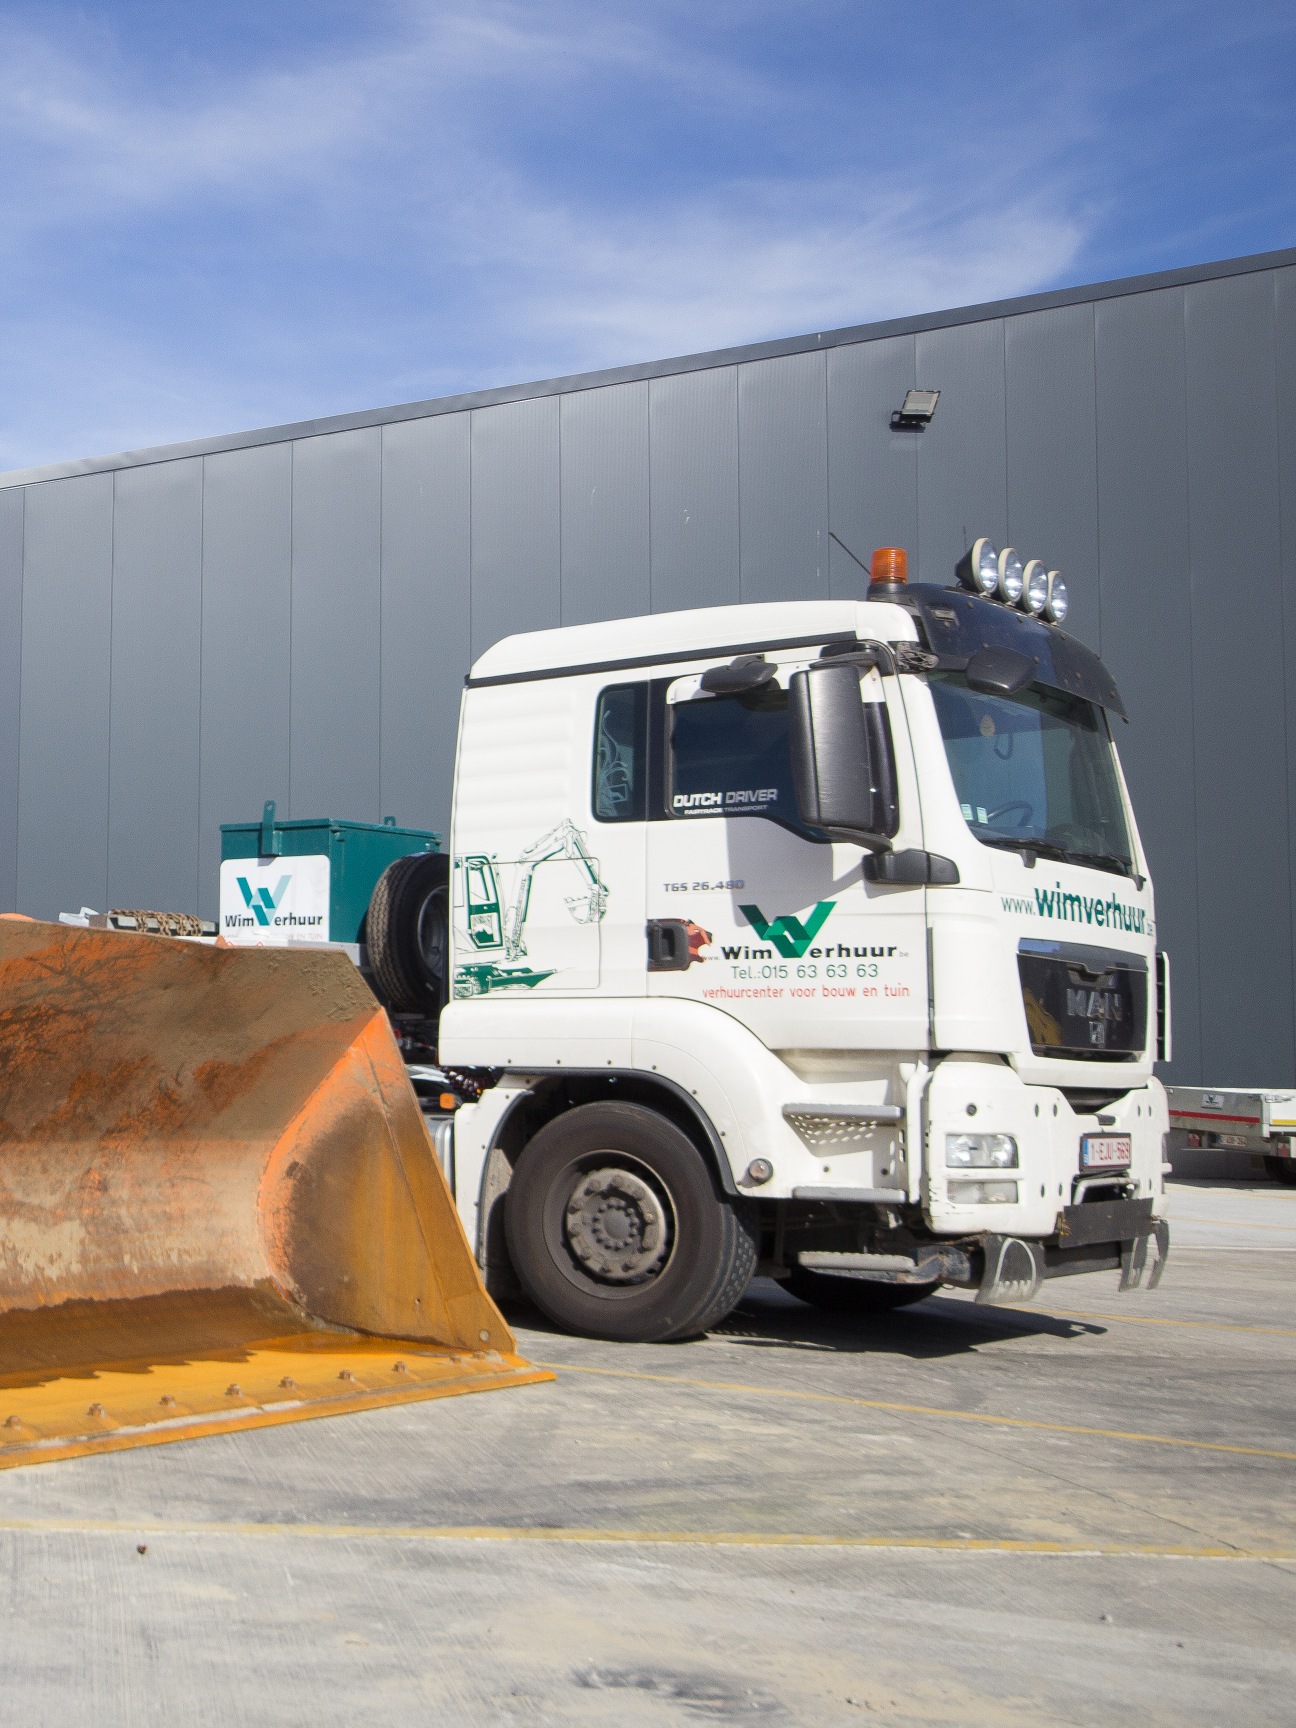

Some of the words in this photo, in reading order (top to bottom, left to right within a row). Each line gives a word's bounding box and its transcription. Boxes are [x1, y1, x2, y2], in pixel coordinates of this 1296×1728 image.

[673, 792, 723, 808] DUTCH
[725, 788, 778, 804] DRIVER
[724, 804, 768, 813] TRANSPORT
[225, 914, 254, 927] Wim
[721, 946, 772, 960] Wim
[731, 965, 788, 979] Tel.:015
[797, 964, 817, 978] 63
[826, 964, 847, 978] 63
[856, 963, 878, 978] 63
[703, 986, 784, 999] verhuurcenter
[789, 986, 816, 998] voor
[822, 984, 856, 997] bouw
[862, 986, 878, 997] en
[884, 982, 910, 997] tuin
[1066, 988, 1123, 1021] MAN
